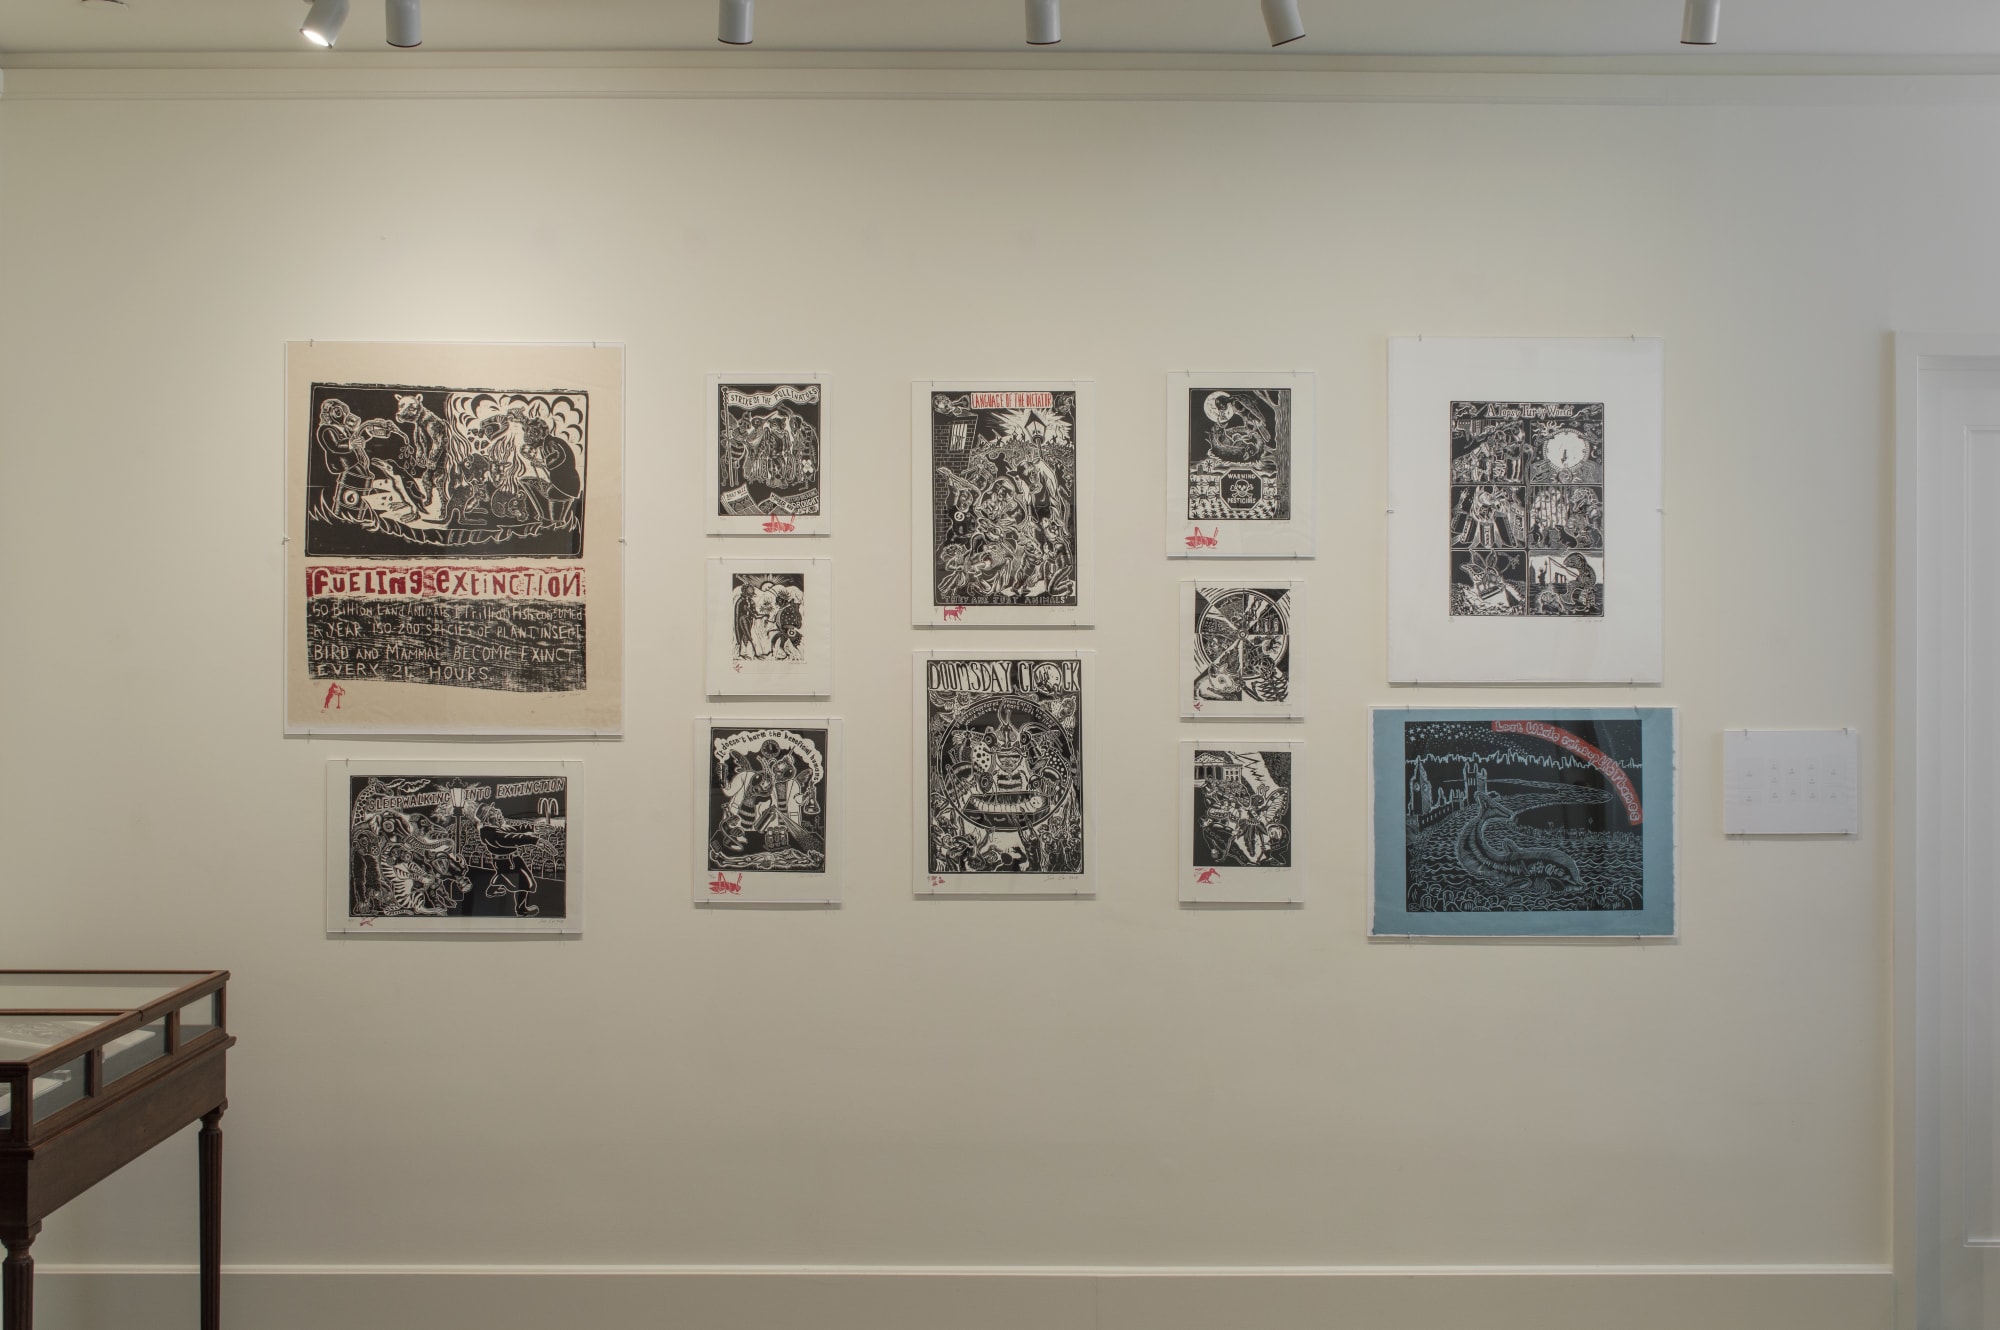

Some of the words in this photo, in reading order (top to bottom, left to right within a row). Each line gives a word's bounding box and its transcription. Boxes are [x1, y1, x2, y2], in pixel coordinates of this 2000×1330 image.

[730, 394, 752, 406] STRIKE
[753, 395, 760, 404] OF
[762, 396, 771, 405] THE
[774, 387, 818, 401] POLLINATORS
[1014, 393, 1024, 407] THE
[372, 622, 420, 634] 150-200
[477, 626, 492, 637] OF
[314, 644, 349, 661] BIRD
[356, 648, 379, 660] AND
[386, 643, 441, 661] MAMMAL
[453, 645, 512, 661] BECOME
[317, 663, 380, 677] EVERY
[391, 664, 415, 678] 24
[429, 666, 489, 681] HOURS
[929, 662, 1011, 691] DOOMSDAY
[747, 732, 767, 743] harm
[768, 730, 782, 738] the
[368, 791, 450, 811] SLEEPWALKING
[464, 786, 492, 801] INTO
[495, 777, 567, 799] EXTINCTION
